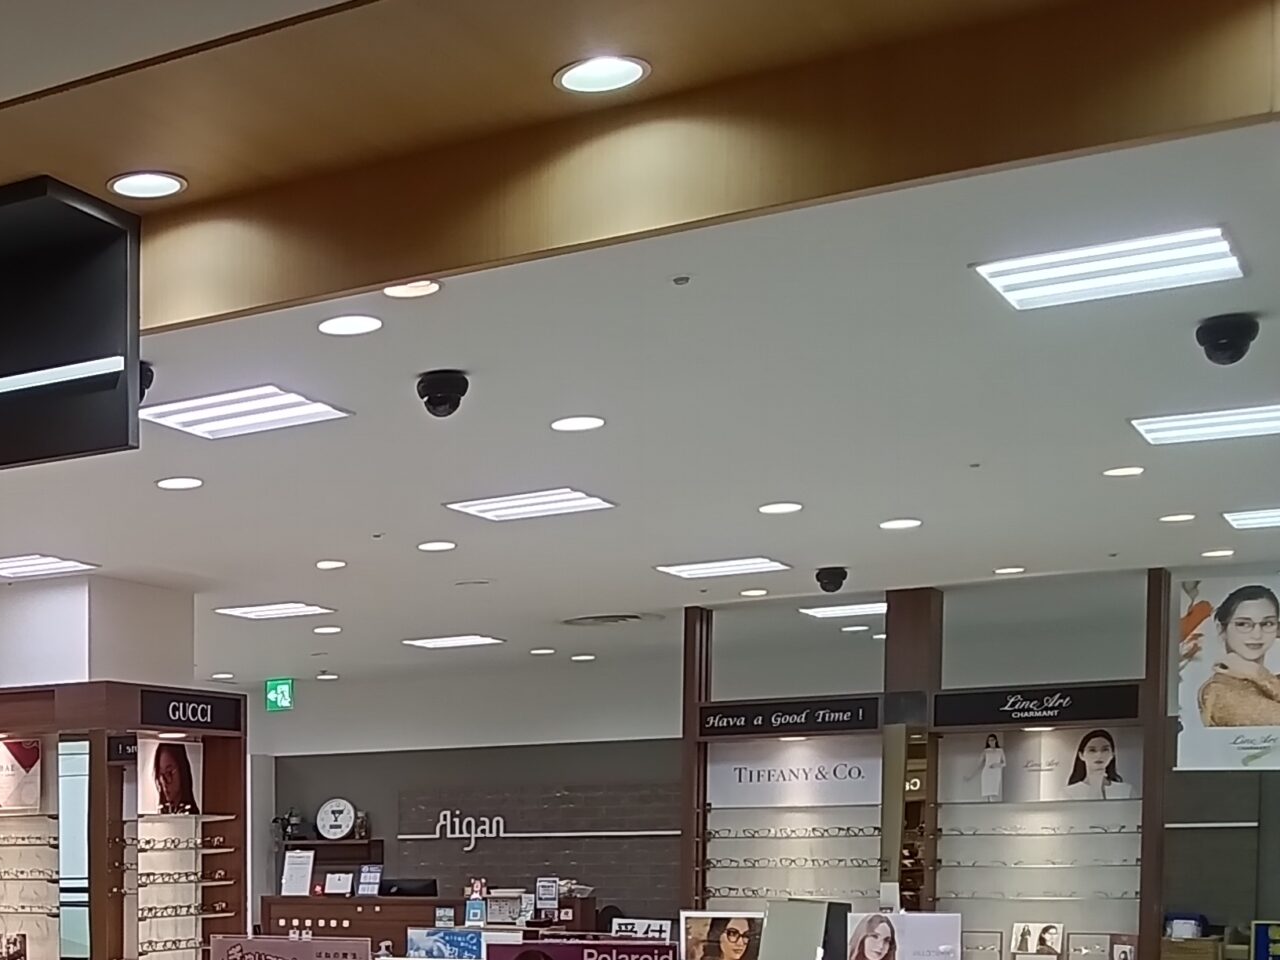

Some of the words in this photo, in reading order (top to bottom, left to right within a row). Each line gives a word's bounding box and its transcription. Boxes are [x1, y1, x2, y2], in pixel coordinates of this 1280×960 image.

[168, 701, 212, 723] GUCCI
[705, 714, 746, 728] Hava
[753, 715, 763, 726] a
[771, 709, 810, 727] Good
[814, 709, 852, 723] Time
[1012, 710, 1059, 718] CHARMANT
[733, 766, 812, 784] TIFFANY
[435, 809, 506, 851] Aigan
